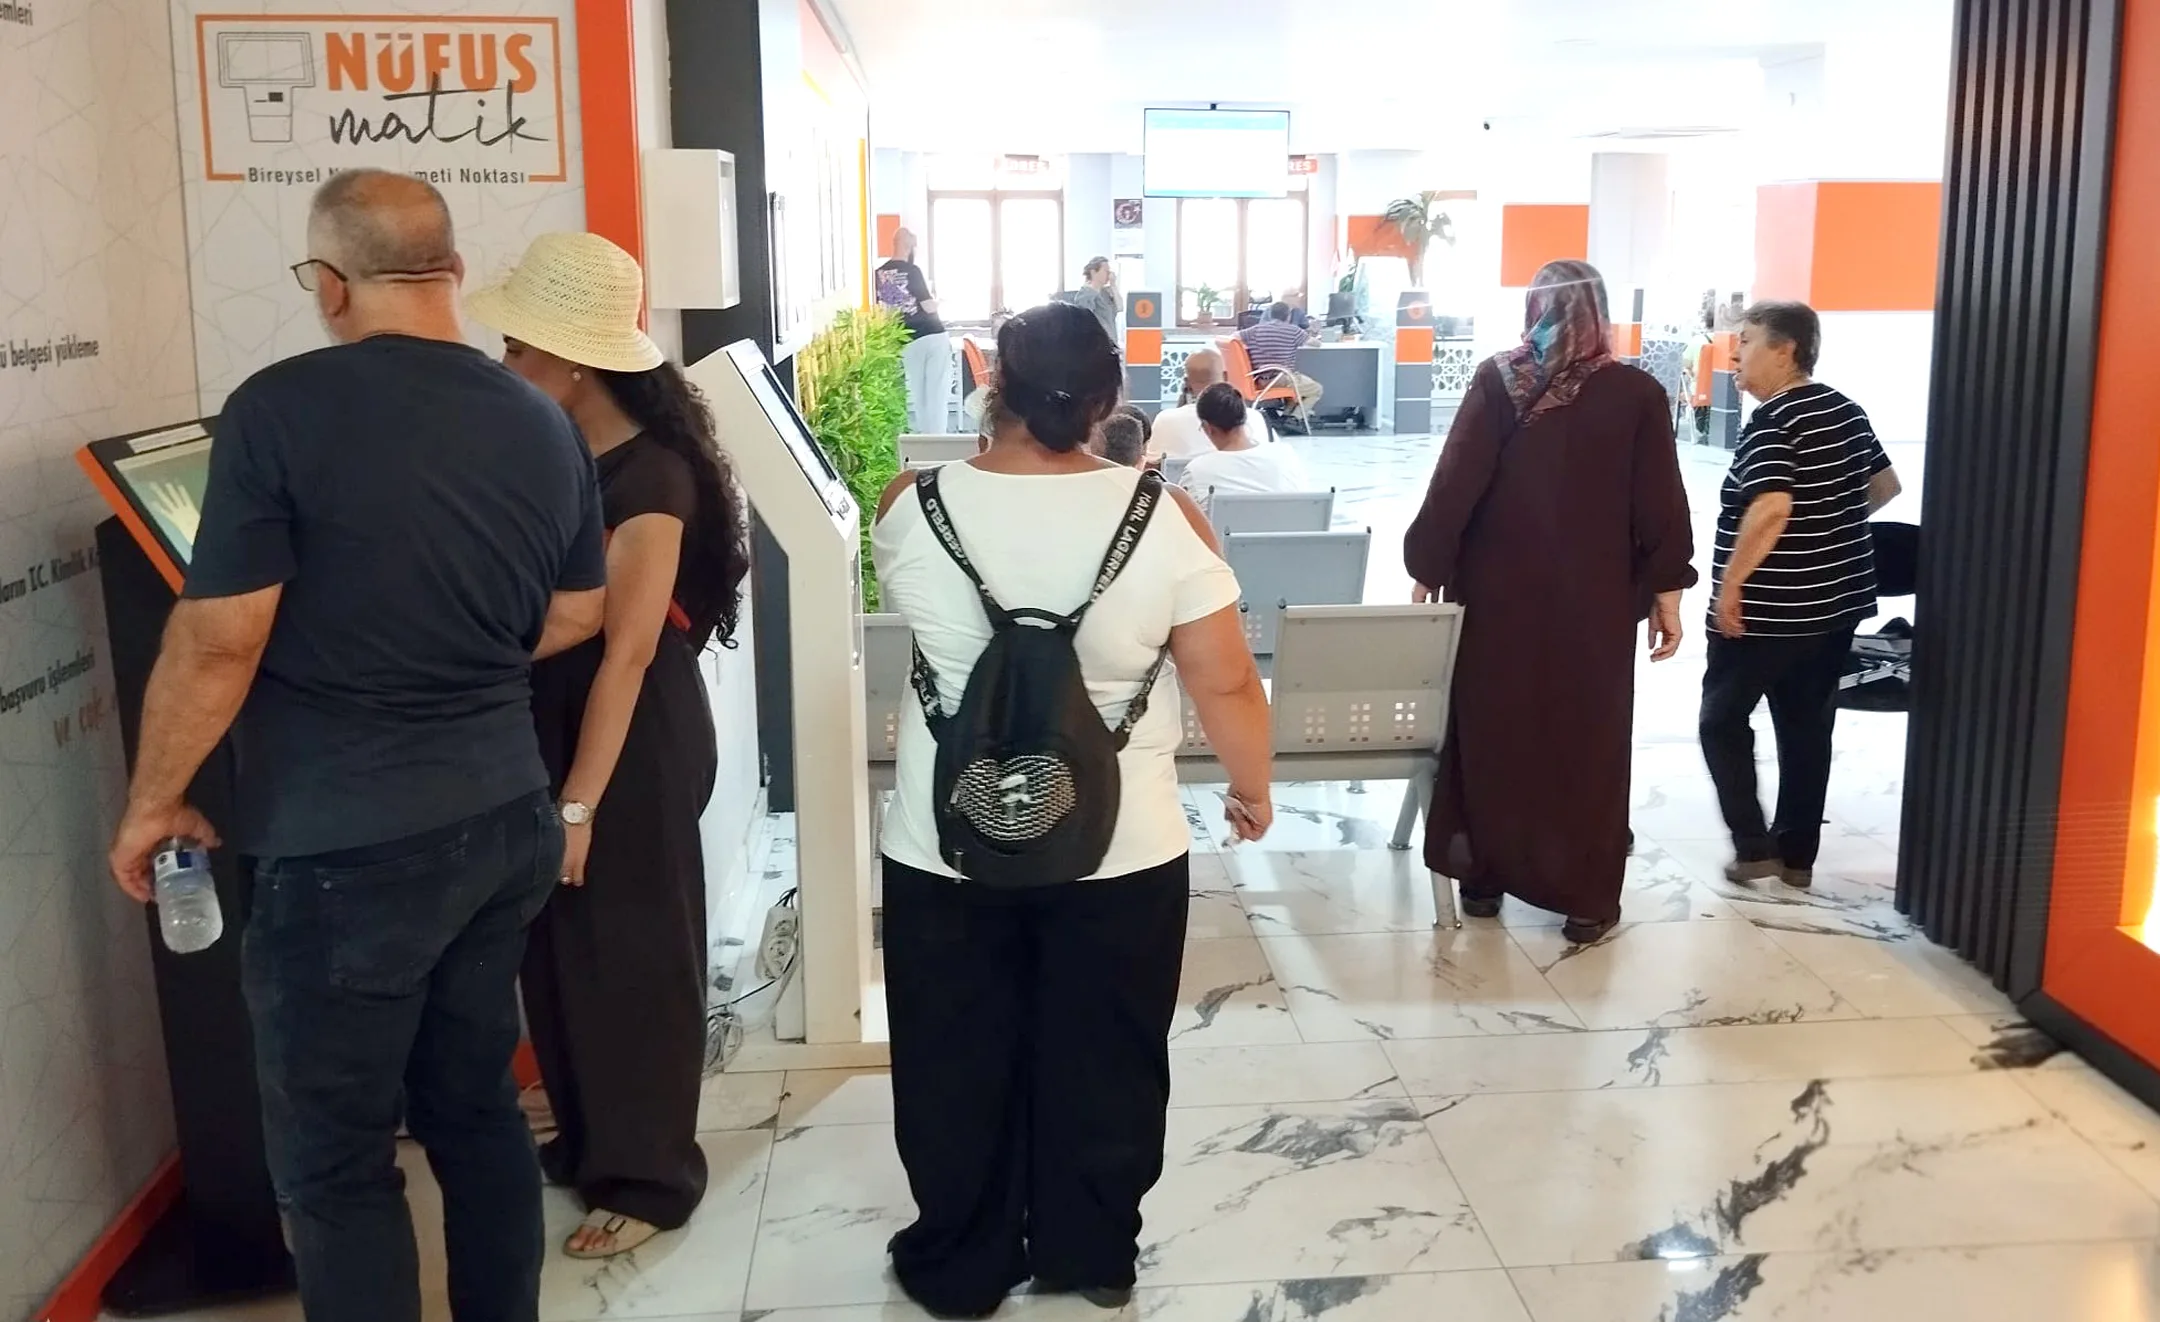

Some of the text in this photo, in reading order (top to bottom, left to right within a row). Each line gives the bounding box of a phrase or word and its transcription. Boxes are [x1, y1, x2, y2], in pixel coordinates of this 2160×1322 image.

[325, 32, 537, 93] NÜFUS
[329, 71, 549, 153] matik
[248, 167, 321, 186] Bireysel
[460, 168, 526, 184] Noktası
[10, 338, 53, 372] belgesi
[55, 333, 100, 368] yükleme
[1128, 491, 1153, 522] KARL
